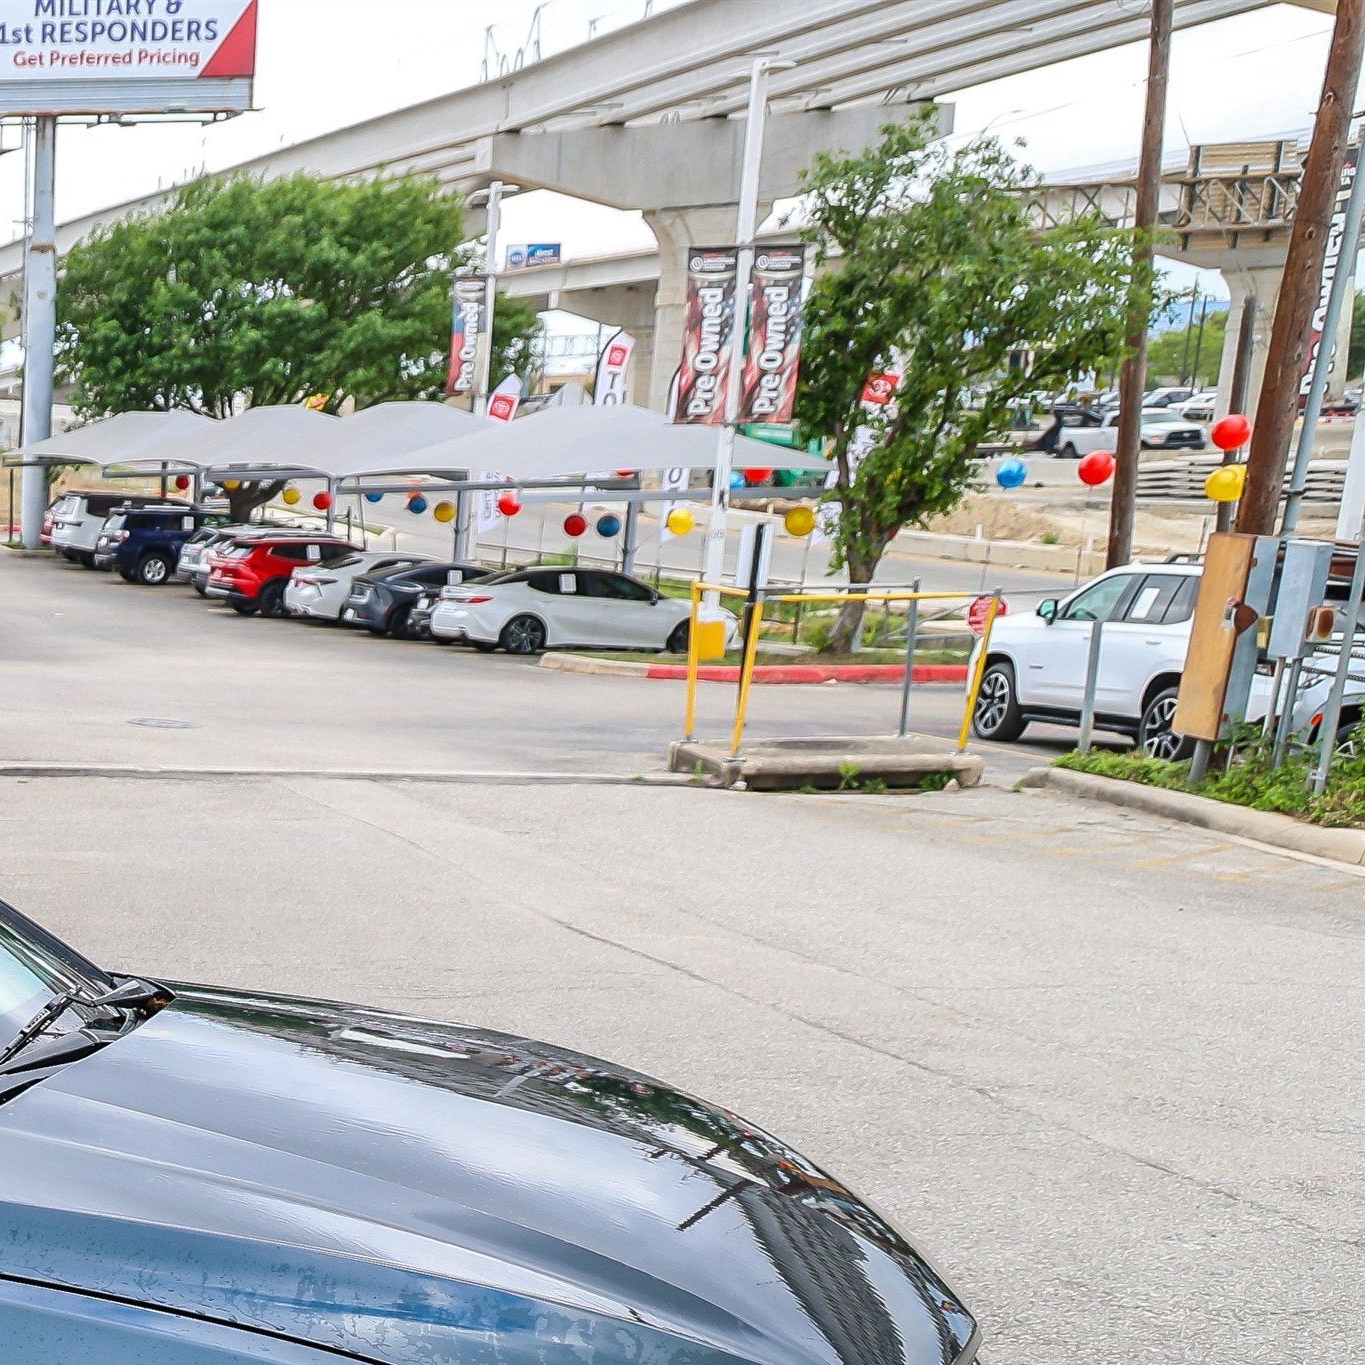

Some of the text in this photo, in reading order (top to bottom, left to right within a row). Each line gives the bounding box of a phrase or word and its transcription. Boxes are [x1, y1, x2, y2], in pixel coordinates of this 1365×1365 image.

[35, 0, 157, 16] MILITARY
[41, 18, 218, 44] RESPONDERS
[13, 49, 200, 68] Get Preferred Pricing
[693, 287, 725, 373] Owned
[758, 285, 790, 371] Owned
[686, 374, 716, 416] Pre
[751, 373, 782, 416] Pre
